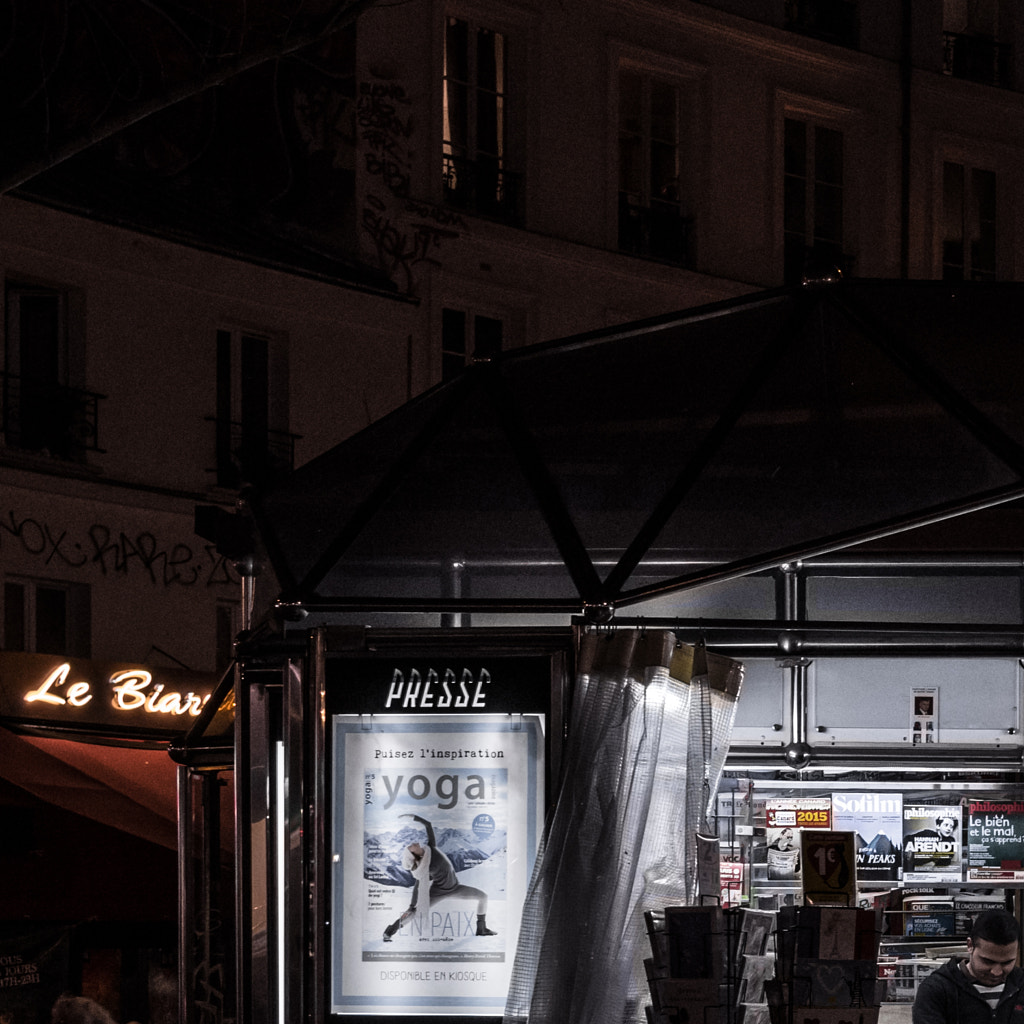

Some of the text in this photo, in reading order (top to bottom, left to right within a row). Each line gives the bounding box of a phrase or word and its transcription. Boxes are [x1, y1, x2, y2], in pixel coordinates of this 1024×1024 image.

[24, 662, 93, 707] Le
[385, 667, 492, 708] PRESSE
[374, 748, 505, 761] Puisez l'inspiration
[382, 773, 486, 810] yoga
[833, 793, 900, 814] Sofilm
[797, 811, 829, 823] 2015
[969, 814, 982, 827] Le
[981, 824, 992, 837] le
[904, 841, 960, 853] ARENDT
[867, 853, 897, 865] PEAKS
[431, 909, 478, 938] PAIX
[380, 970, 488, 983] DISPONIBLE EN KIOSQUE
